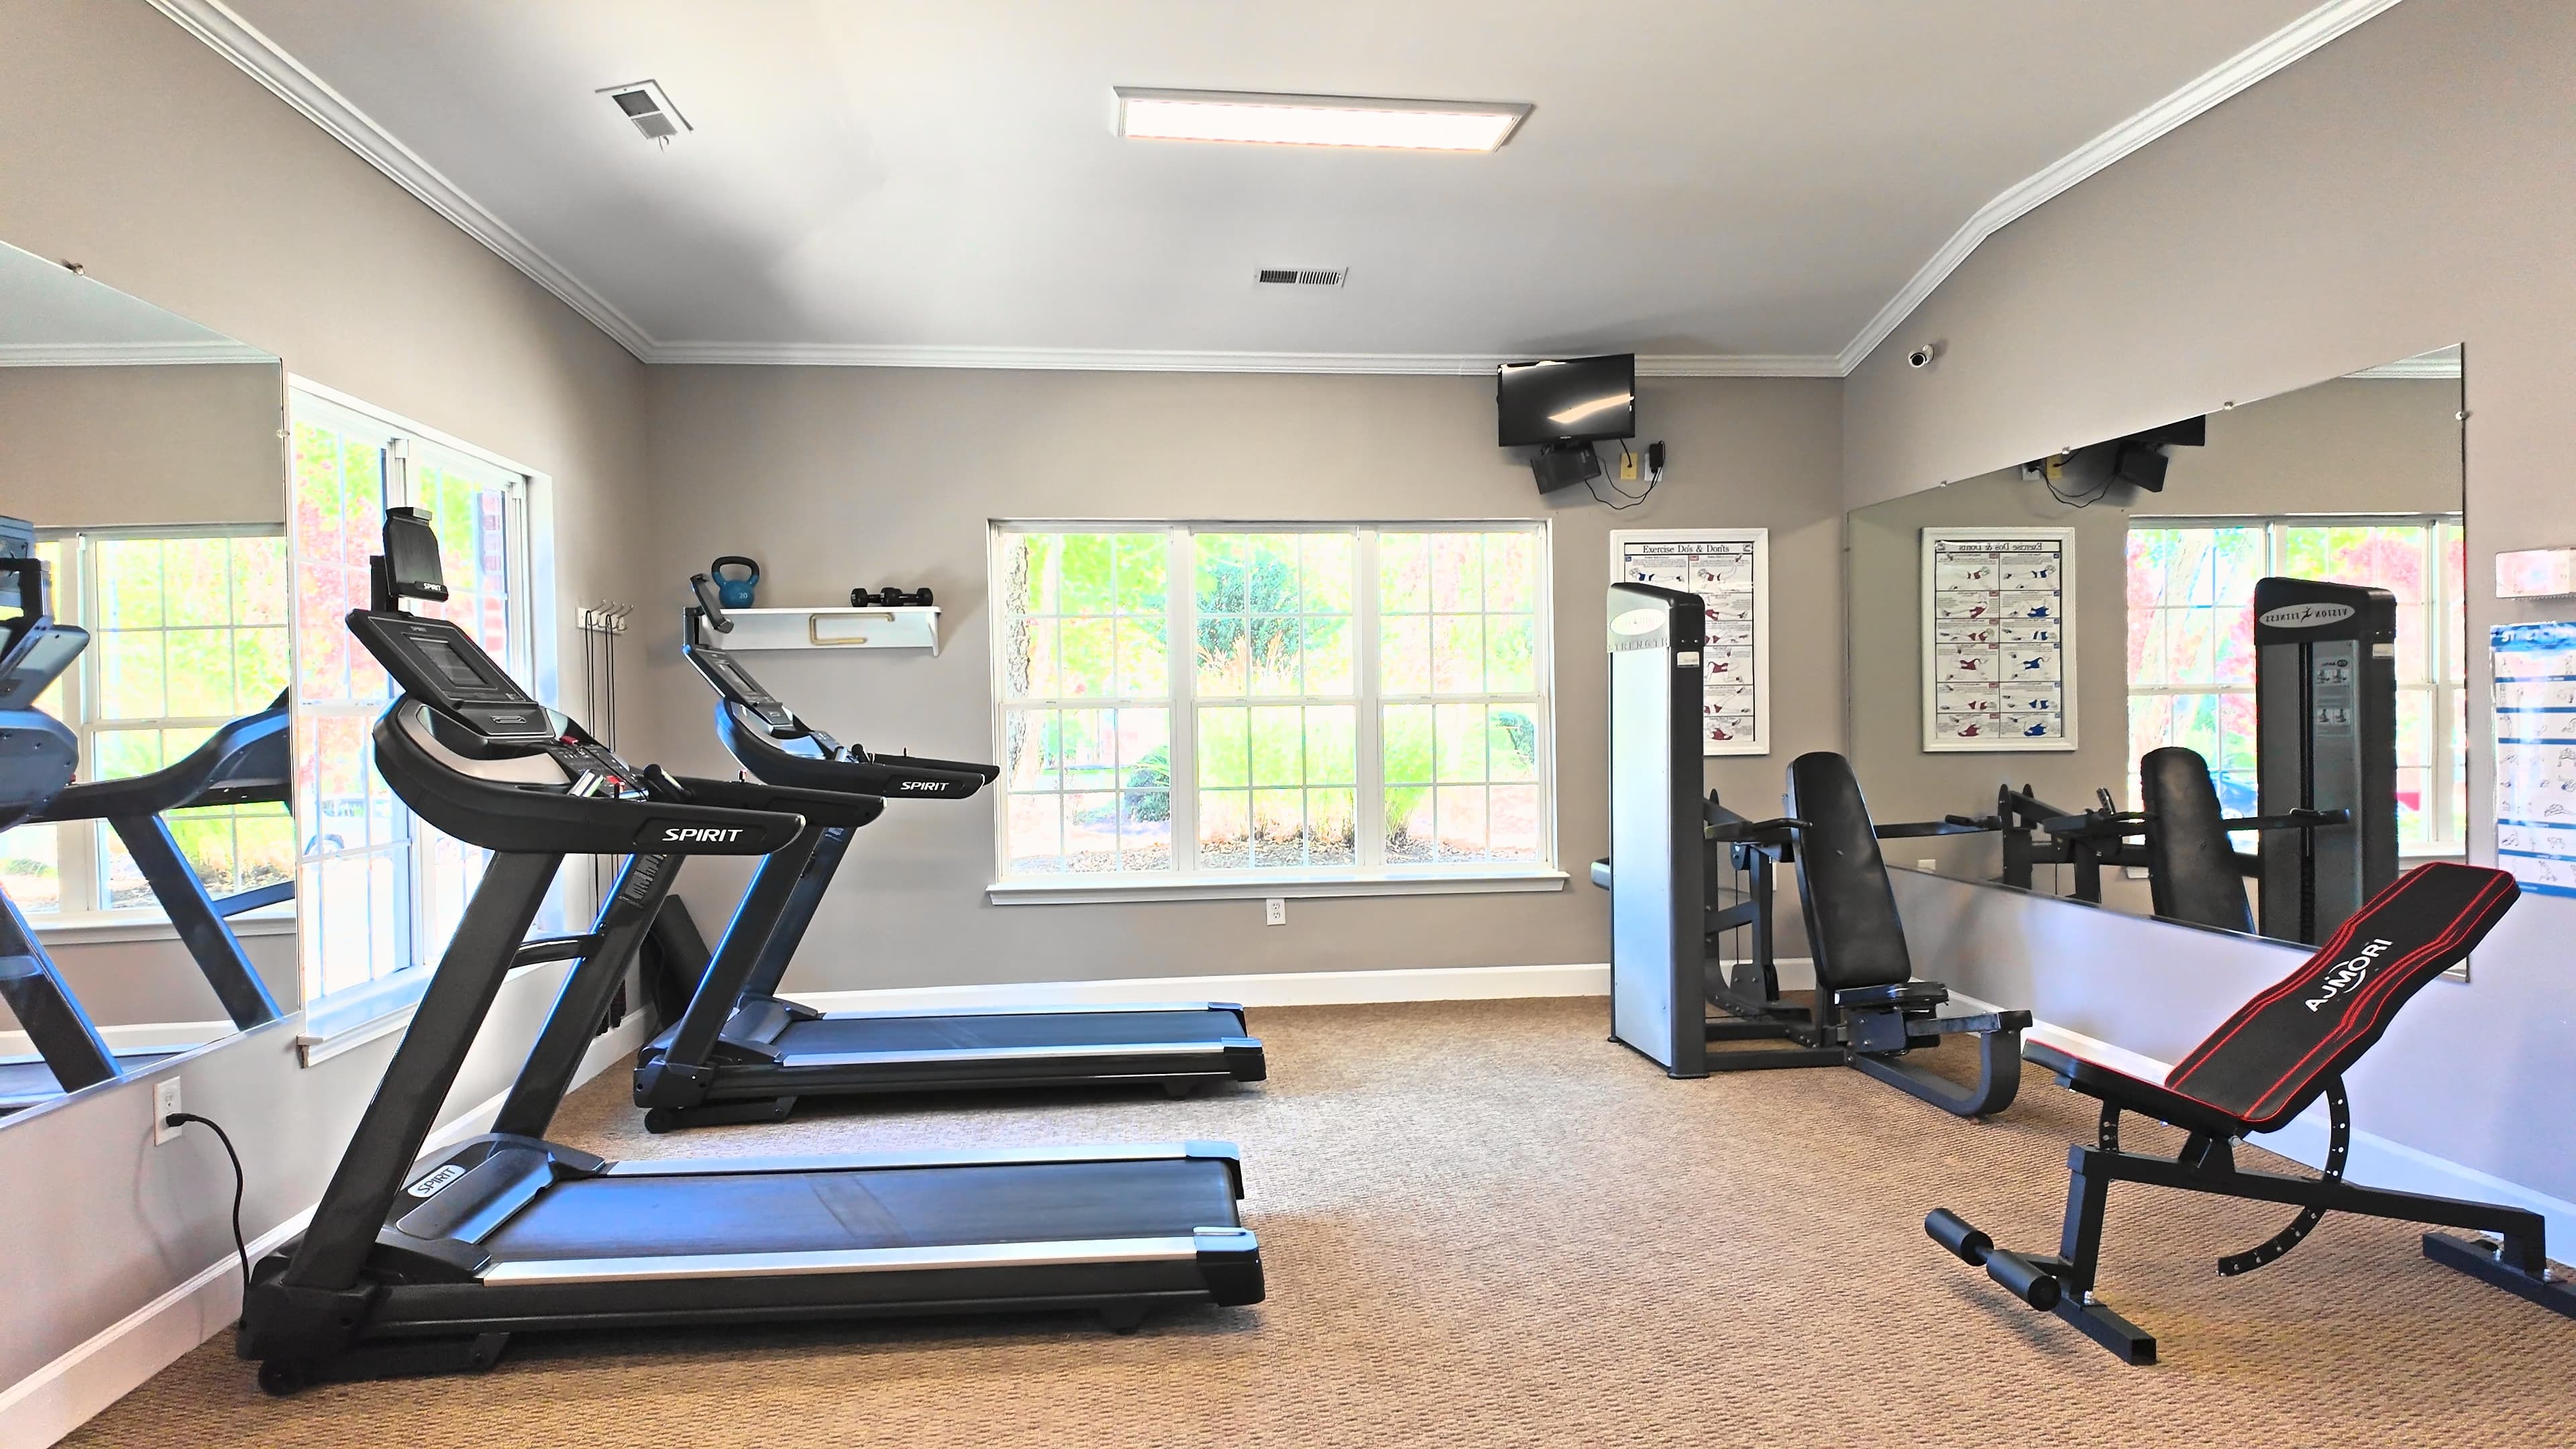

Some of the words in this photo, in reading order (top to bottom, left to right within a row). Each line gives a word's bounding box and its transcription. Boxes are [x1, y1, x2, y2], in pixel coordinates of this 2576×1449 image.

[1643, 545, 1674, 553] Exercise
[1678, 544, 1693, 553] Do's
[1696, 545, 1703, 553] &
[1707, 544, 1729, 553] Don'ts
[900, 782, 950, 791] SPIRIT
[661, 828, 743, 842] SPIRIT
[2305, 938, 2393, 1012] AJMORI
[417, 1167, 455, 1194] SPIRIT
